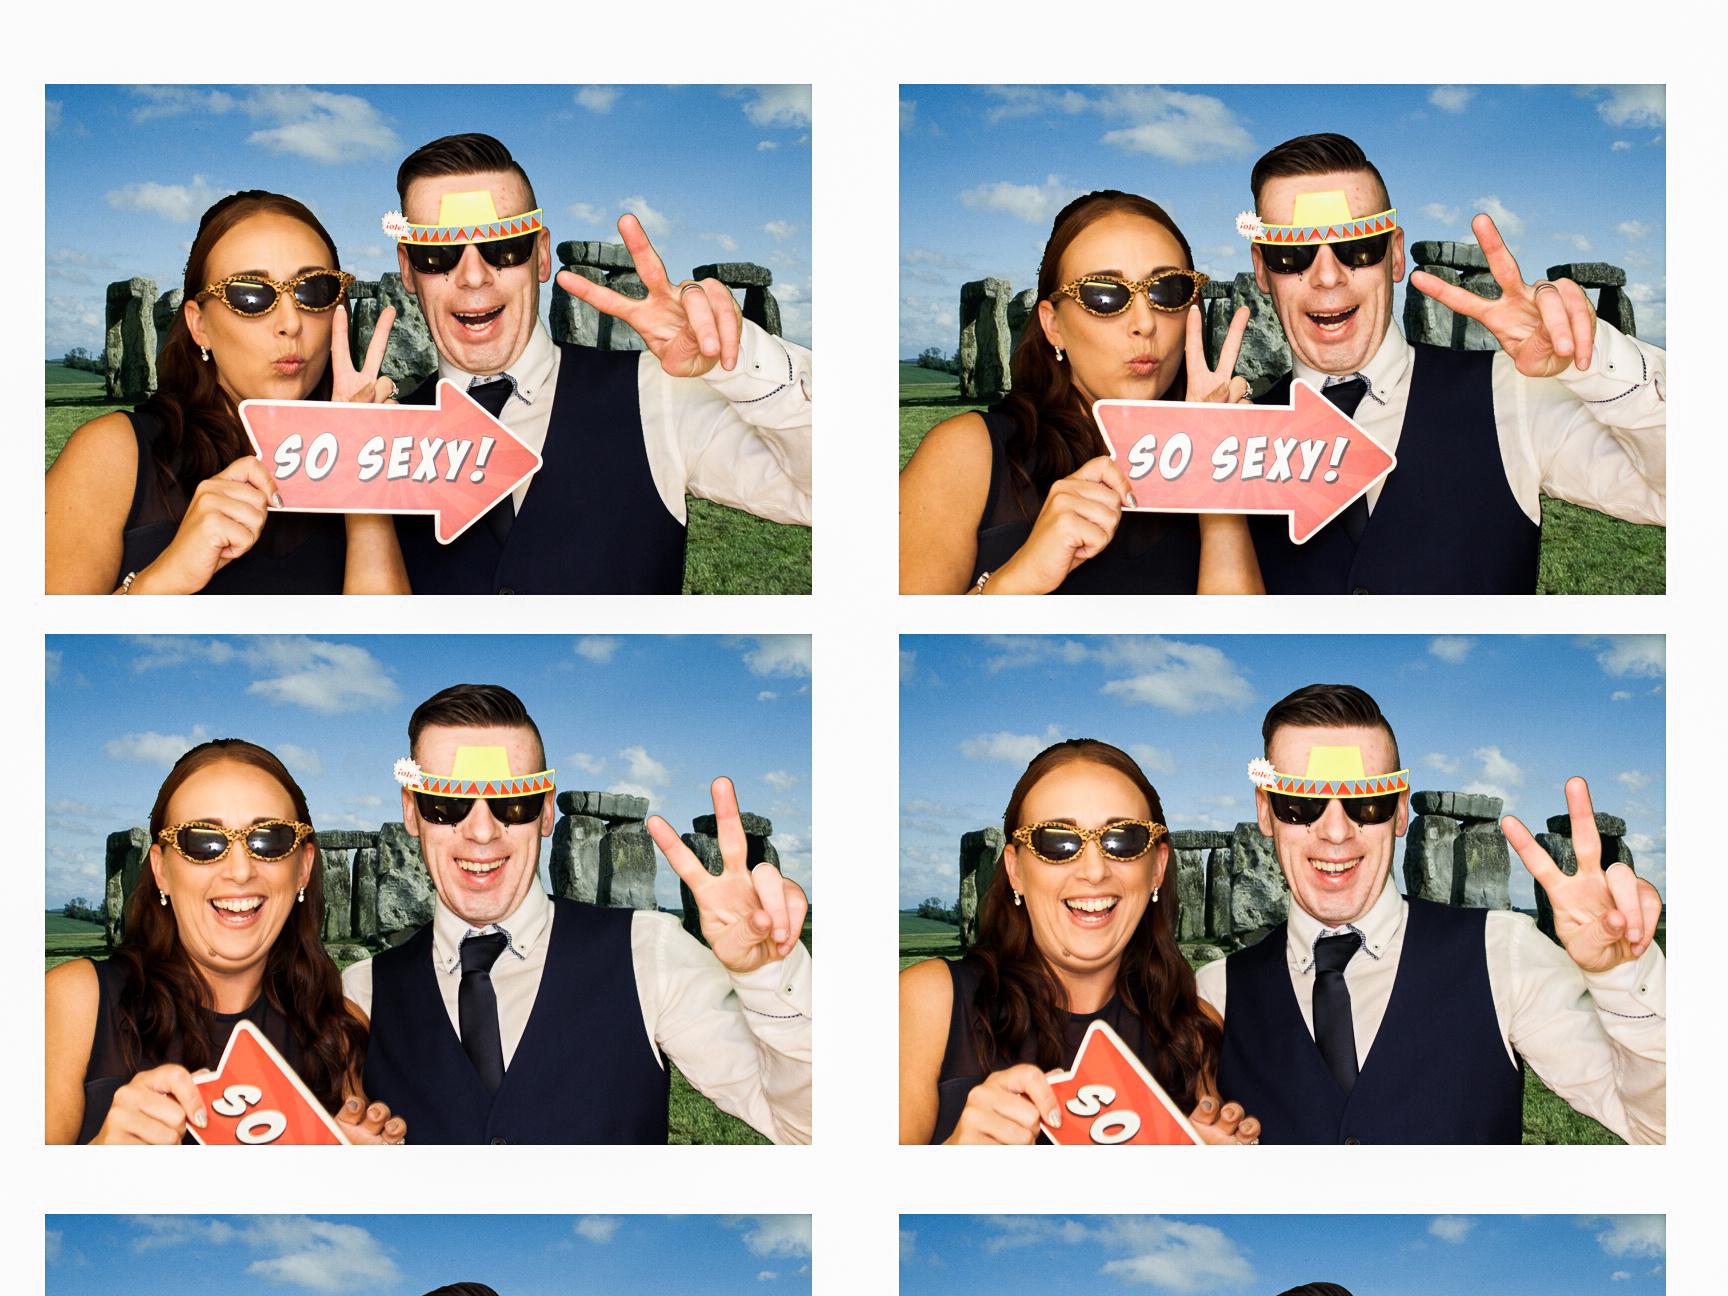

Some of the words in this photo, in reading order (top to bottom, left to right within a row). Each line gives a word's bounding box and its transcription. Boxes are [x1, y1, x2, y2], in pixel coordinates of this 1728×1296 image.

[273, 432, 340, 480] SO
[357, 435, 496, 484] SEXY!
[1127, 432, 1194, 480] SO
[1211, 435, 1350, 484] SEXY!
[211, 1084, 288, 1144] SO
[1065, 1084, 1142, 1144] SO
